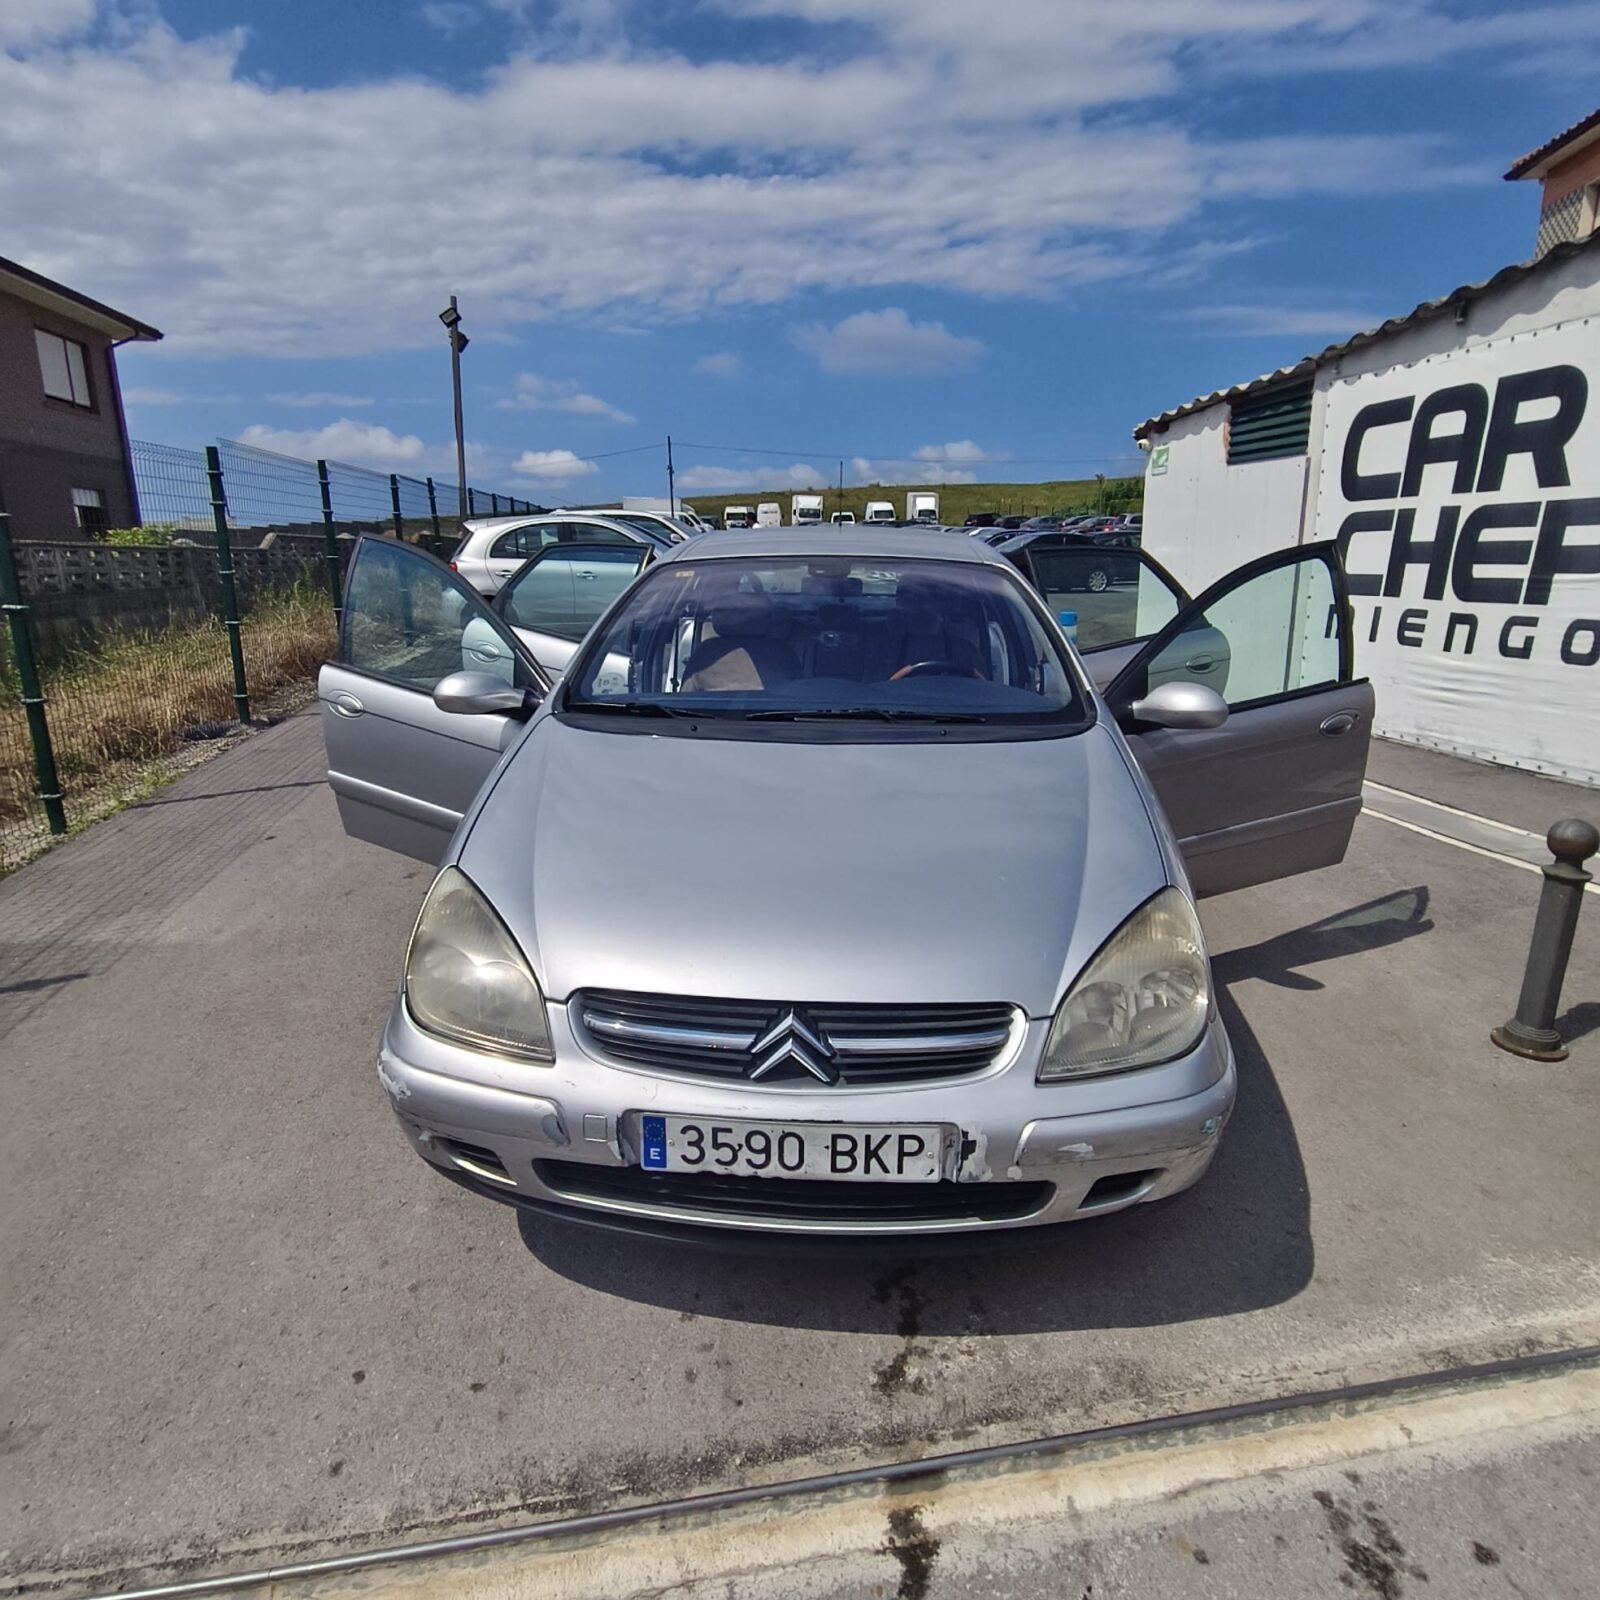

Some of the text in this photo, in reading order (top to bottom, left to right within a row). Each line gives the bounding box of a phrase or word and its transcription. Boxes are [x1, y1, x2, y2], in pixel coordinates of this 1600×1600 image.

[1340, 364, 1589, 502] CAR
[649, 1147, 661, 1161] E
[679, 1124, 926, 1175] 3590 BKP
